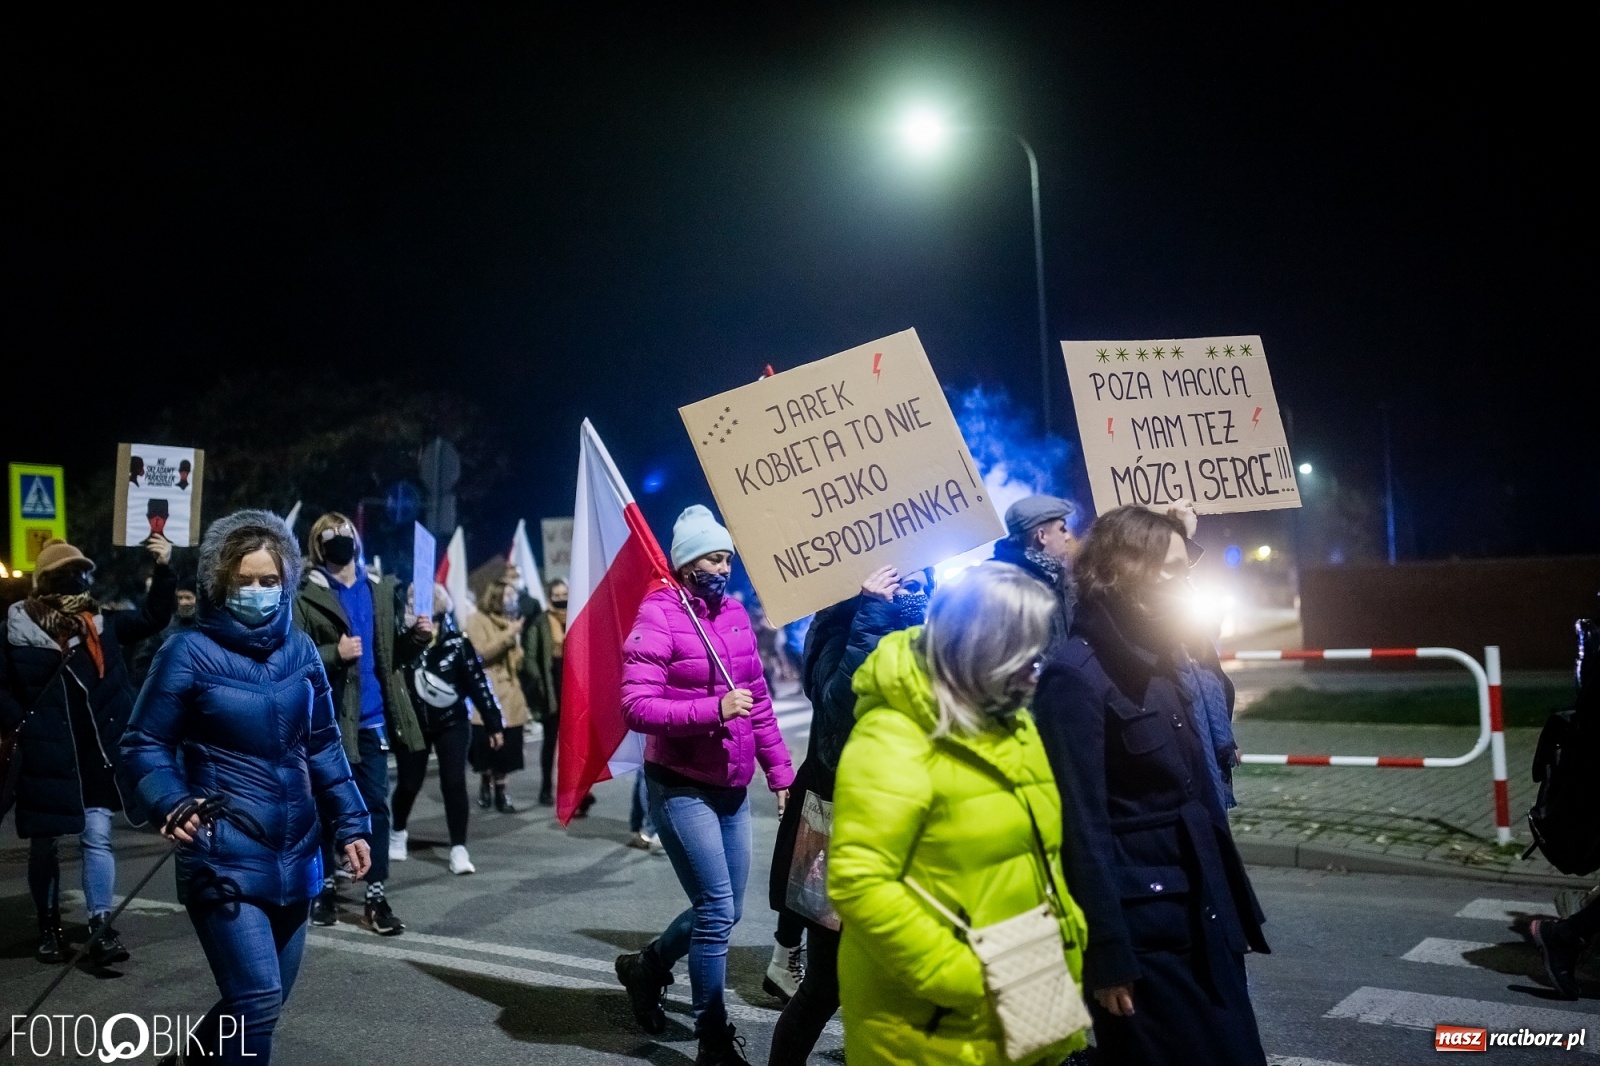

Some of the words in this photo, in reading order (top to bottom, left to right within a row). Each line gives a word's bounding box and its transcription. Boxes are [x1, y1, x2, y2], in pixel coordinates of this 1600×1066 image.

[765, 380, 855, 434] JAREK
[1089, 371, 1153, 401] POZA
[1162, 365, 1252, 398] MACICĄ
[734, 429, 847, 496] KOBIETA
[844, 414, 884, 450] TO
[884, 396, 932, 437] NIE
[1131, 414, 1188, 450] MAM
[802, 463, 889, 518] JAJKO
[1110, 455, 1184, 507] MÓZG
